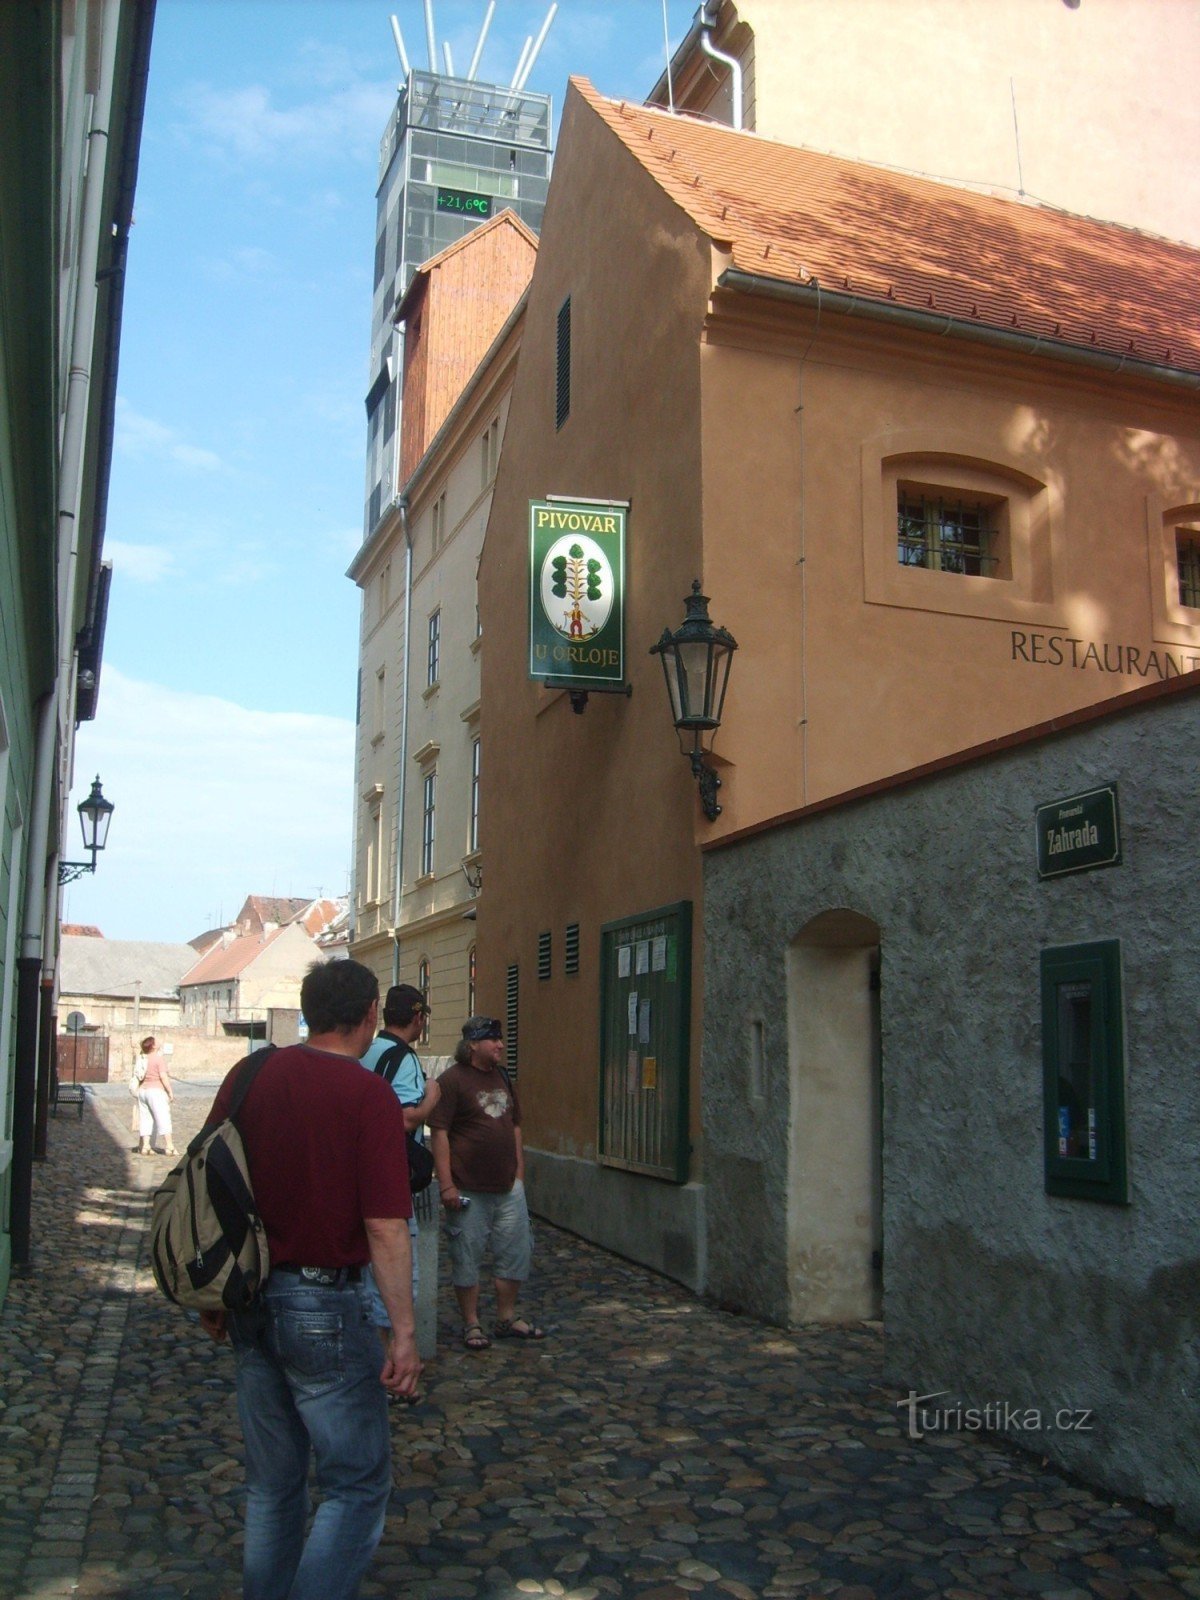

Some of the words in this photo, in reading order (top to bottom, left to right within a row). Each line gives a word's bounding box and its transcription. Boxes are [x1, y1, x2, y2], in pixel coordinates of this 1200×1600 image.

[537, 511, 617, 533] PIVOVAR
[535, 644, 548, 659] U
[552, 646, 619, 668] ORLOJE
[1047, 820, 1099, 856] Zahrada
